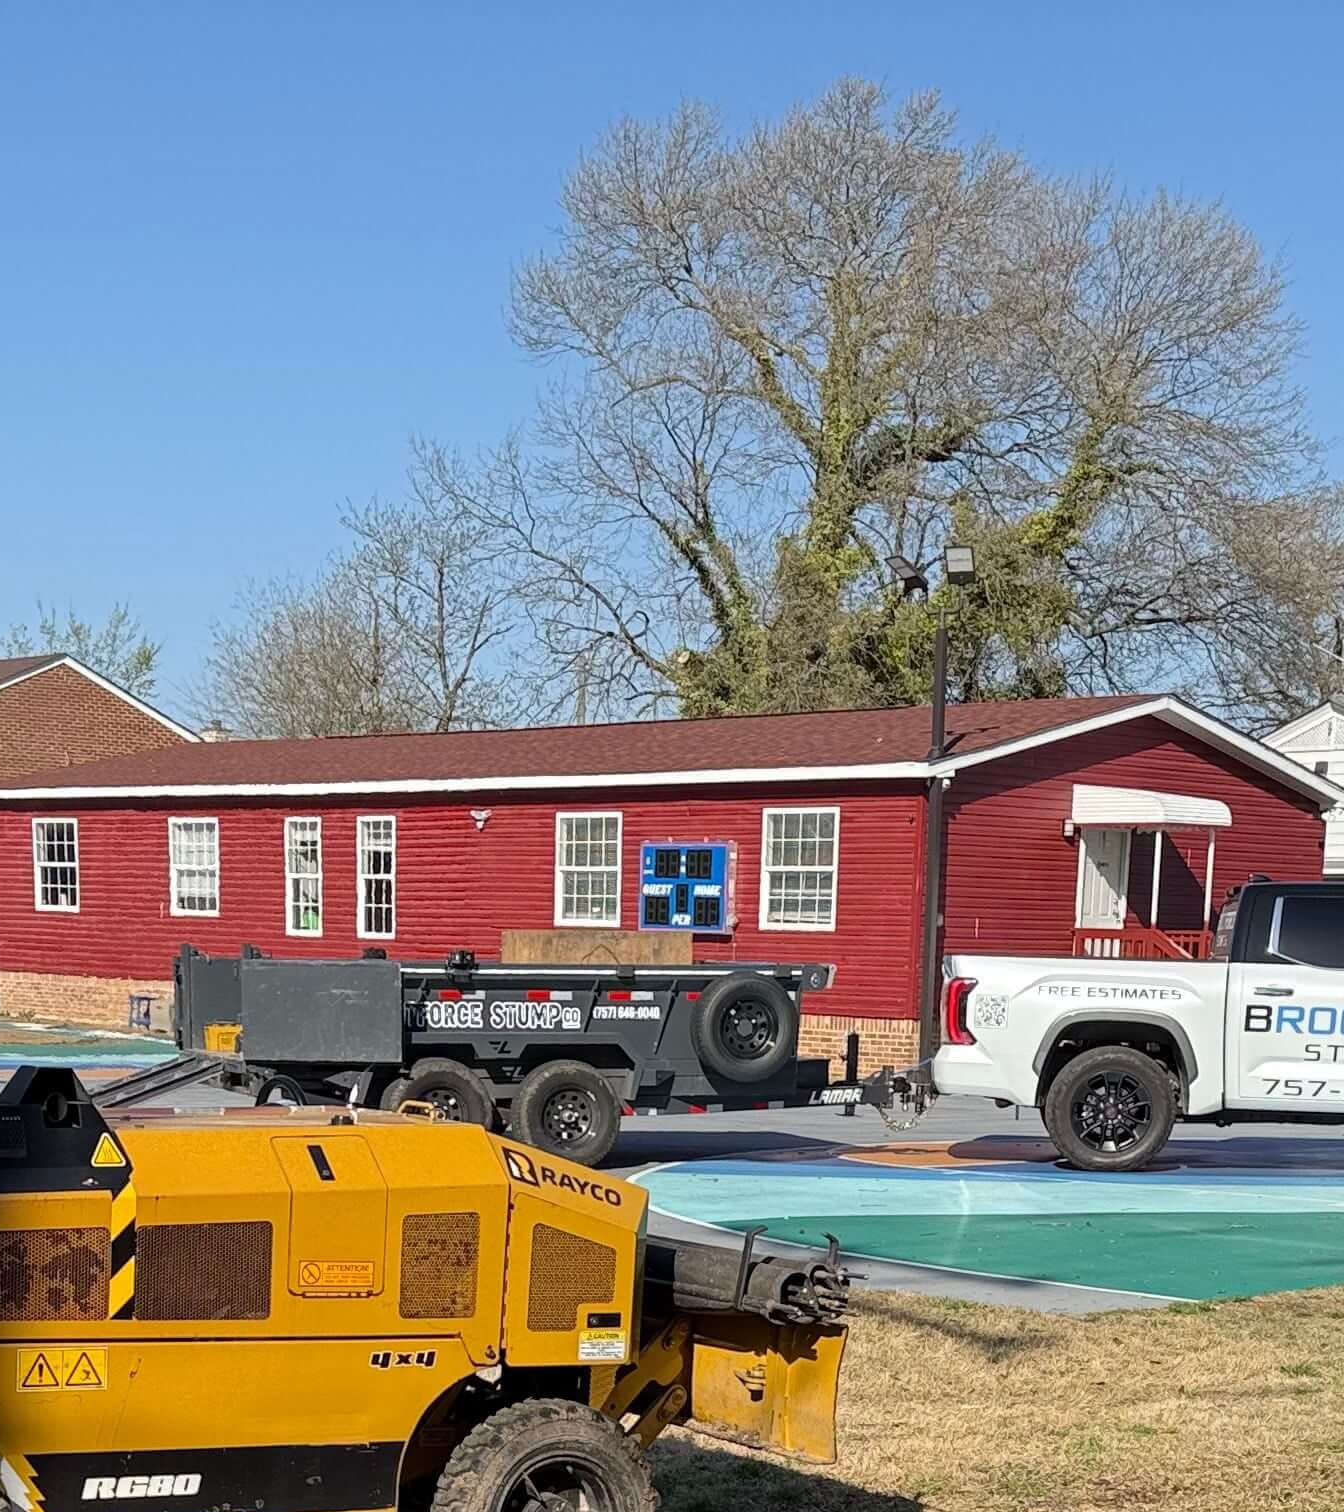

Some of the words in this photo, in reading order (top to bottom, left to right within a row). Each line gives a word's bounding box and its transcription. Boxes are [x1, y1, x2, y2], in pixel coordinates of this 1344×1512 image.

[1038, 985, 1081, 997] FREE
[1087, 987, 1183, 1000] ESTIMATES
[490, 1002, 562, 1029] STUMP
[808, 1088, 864, 1105] LAMAR
[540, 1166, 622, 1207] RAYCO
[369, 1350, 439, 1370] 4x4
[81, 1473, 202, 1501] RG80
